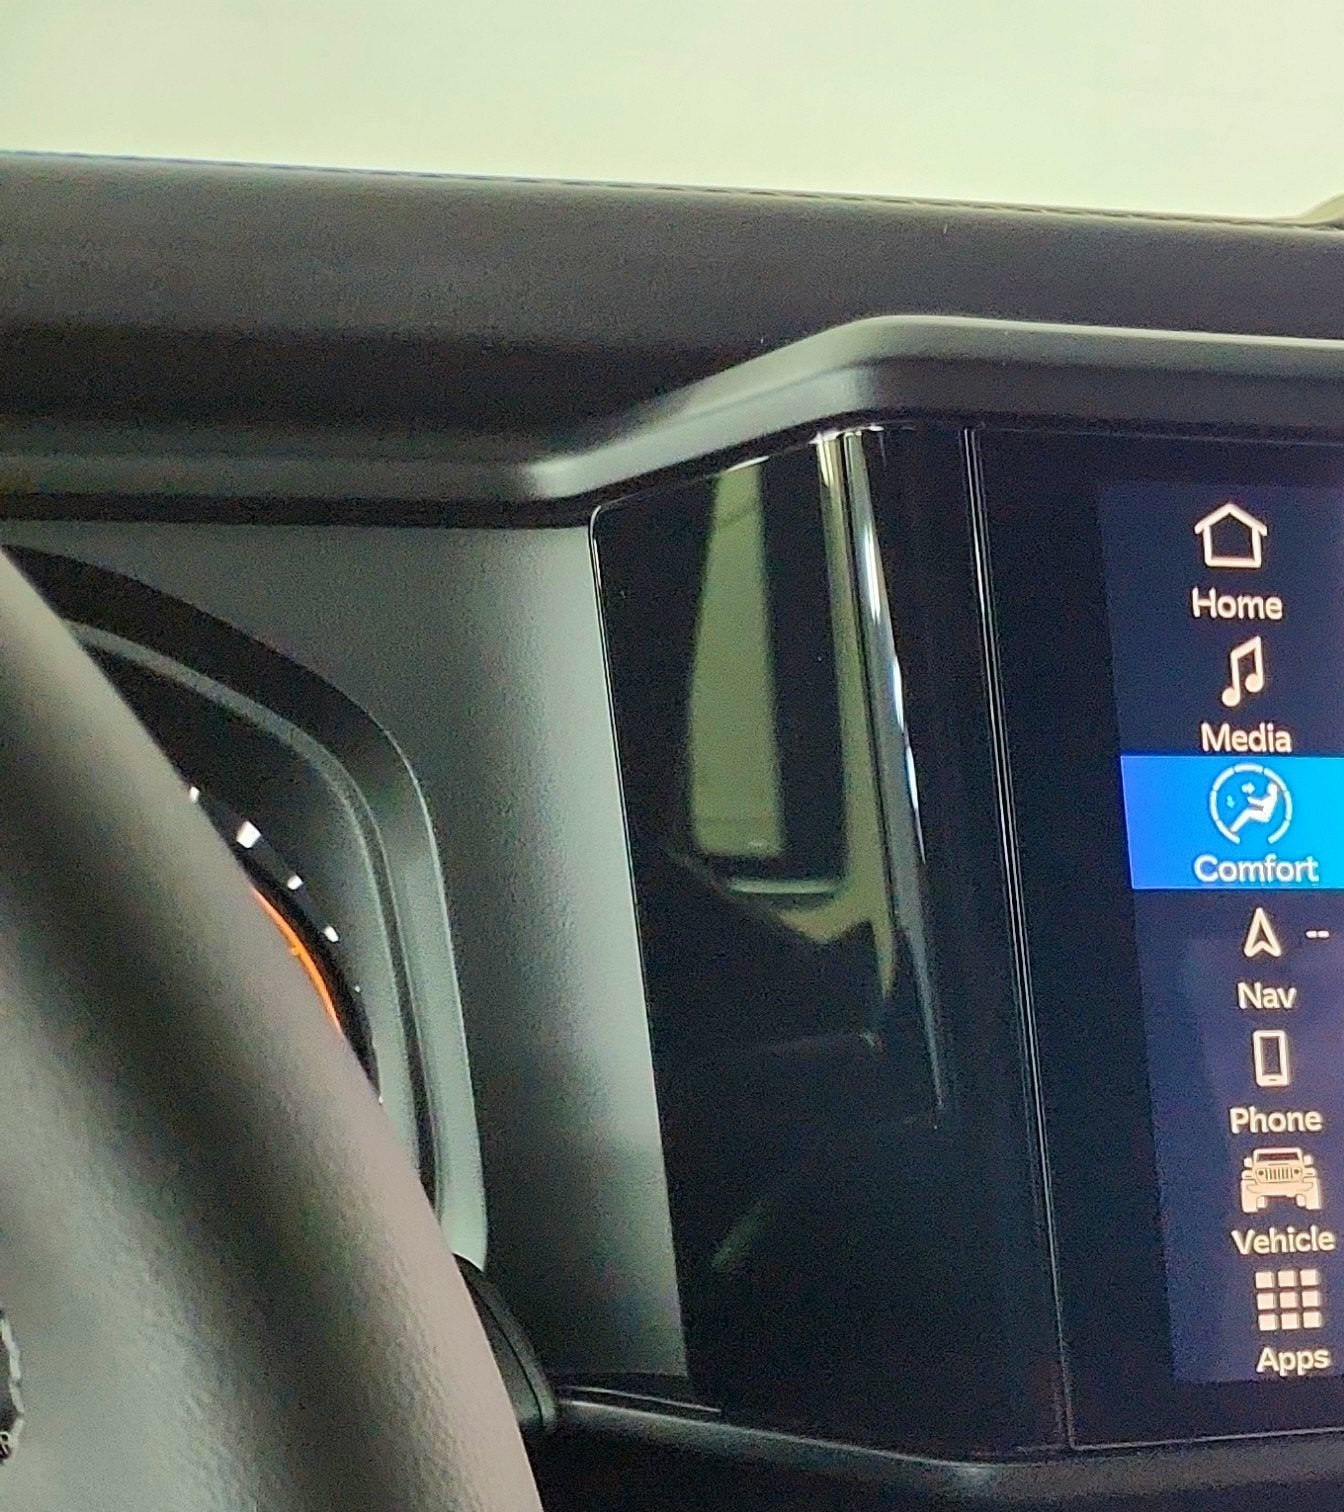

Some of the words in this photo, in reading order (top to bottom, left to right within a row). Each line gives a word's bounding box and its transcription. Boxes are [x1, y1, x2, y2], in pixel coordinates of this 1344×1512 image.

[1191, 586, 1283, 620] Home
[1200, 722, 1292, 754] Media
[1193, 854, 1320, 884] Comfort
[1237, 981, 1297, 1011] Nav
[1229, 1107, 1323, 1135] Phone
[1231, 1227, 1336, 1256] Vehicle
[1256, 1347, 1331, 1378] Apps
